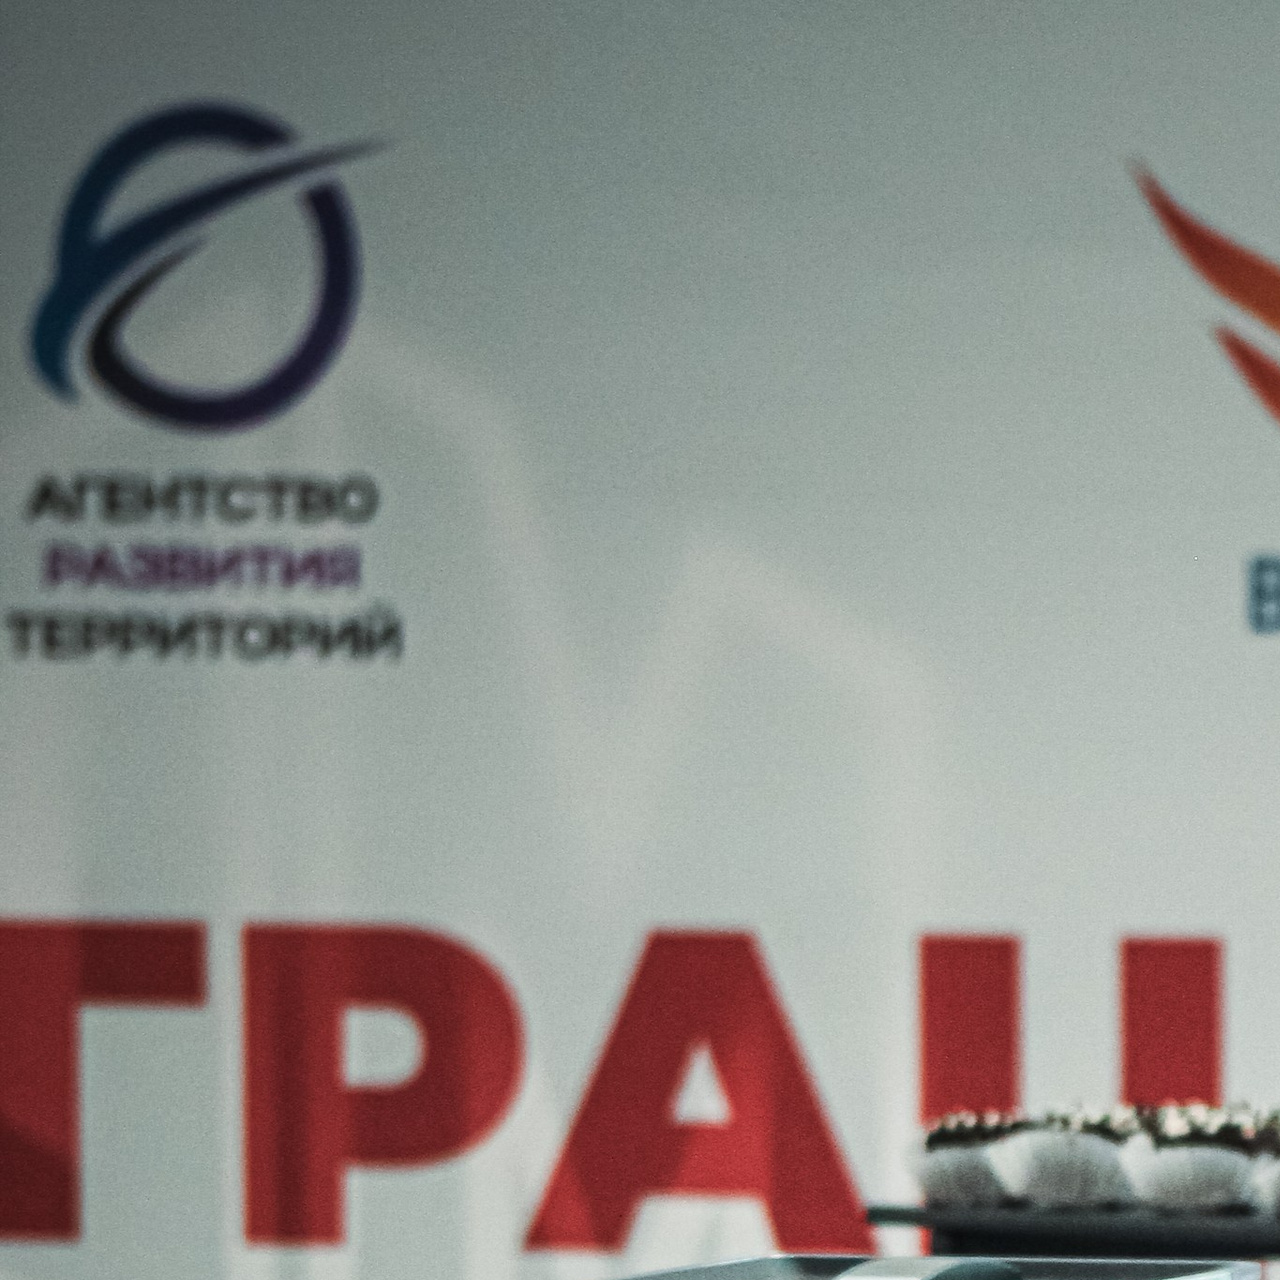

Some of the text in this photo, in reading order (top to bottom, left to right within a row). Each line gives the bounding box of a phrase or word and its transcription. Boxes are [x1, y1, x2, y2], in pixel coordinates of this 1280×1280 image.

[28, 472, 382, 526] АГЕНТСТВО
[42, 542, 364, 592] РАЗВИТИЯ
[8, 600, 405, 664] ТЕРРИТОРИЙ
